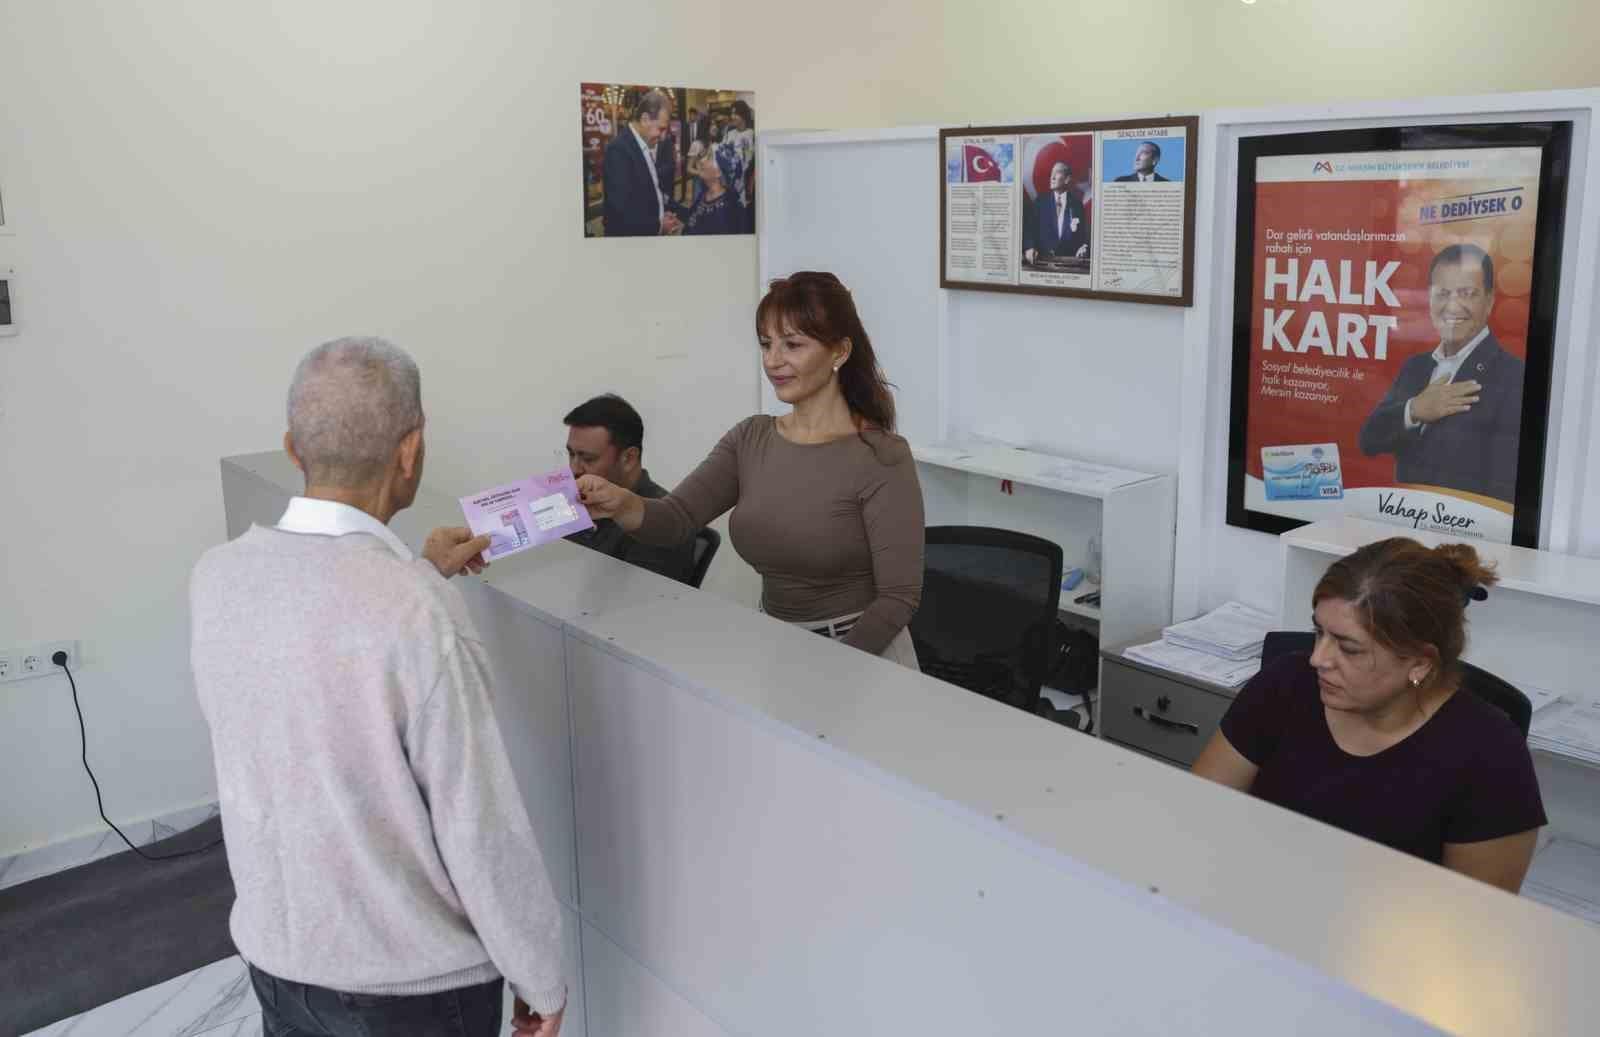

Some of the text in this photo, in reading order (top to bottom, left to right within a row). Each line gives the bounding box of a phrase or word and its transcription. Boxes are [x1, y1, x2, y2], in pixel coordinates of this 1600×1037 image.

[1419, 196, 1523, 220] NE DEDİYSEK O
[1266, 228, 1407, 243] Dar gelirli vatandaşlarımızın
[1296, 243, 1312, 256] için
[1264, 257, 1401, 307] HALK
[1262, 308, 1398, 360] KART
[1262, 360, 1366, 380] Sosyal belediyecilik ile
[1262, 374, 1281, 386] halk
[1261, 385, 1292, 399] Mersin
[1321, 487, 1339, 495] VISA
[1378, 491, 1429, 529] Vahap
[1432, 502, 1475, 528] Seçer
